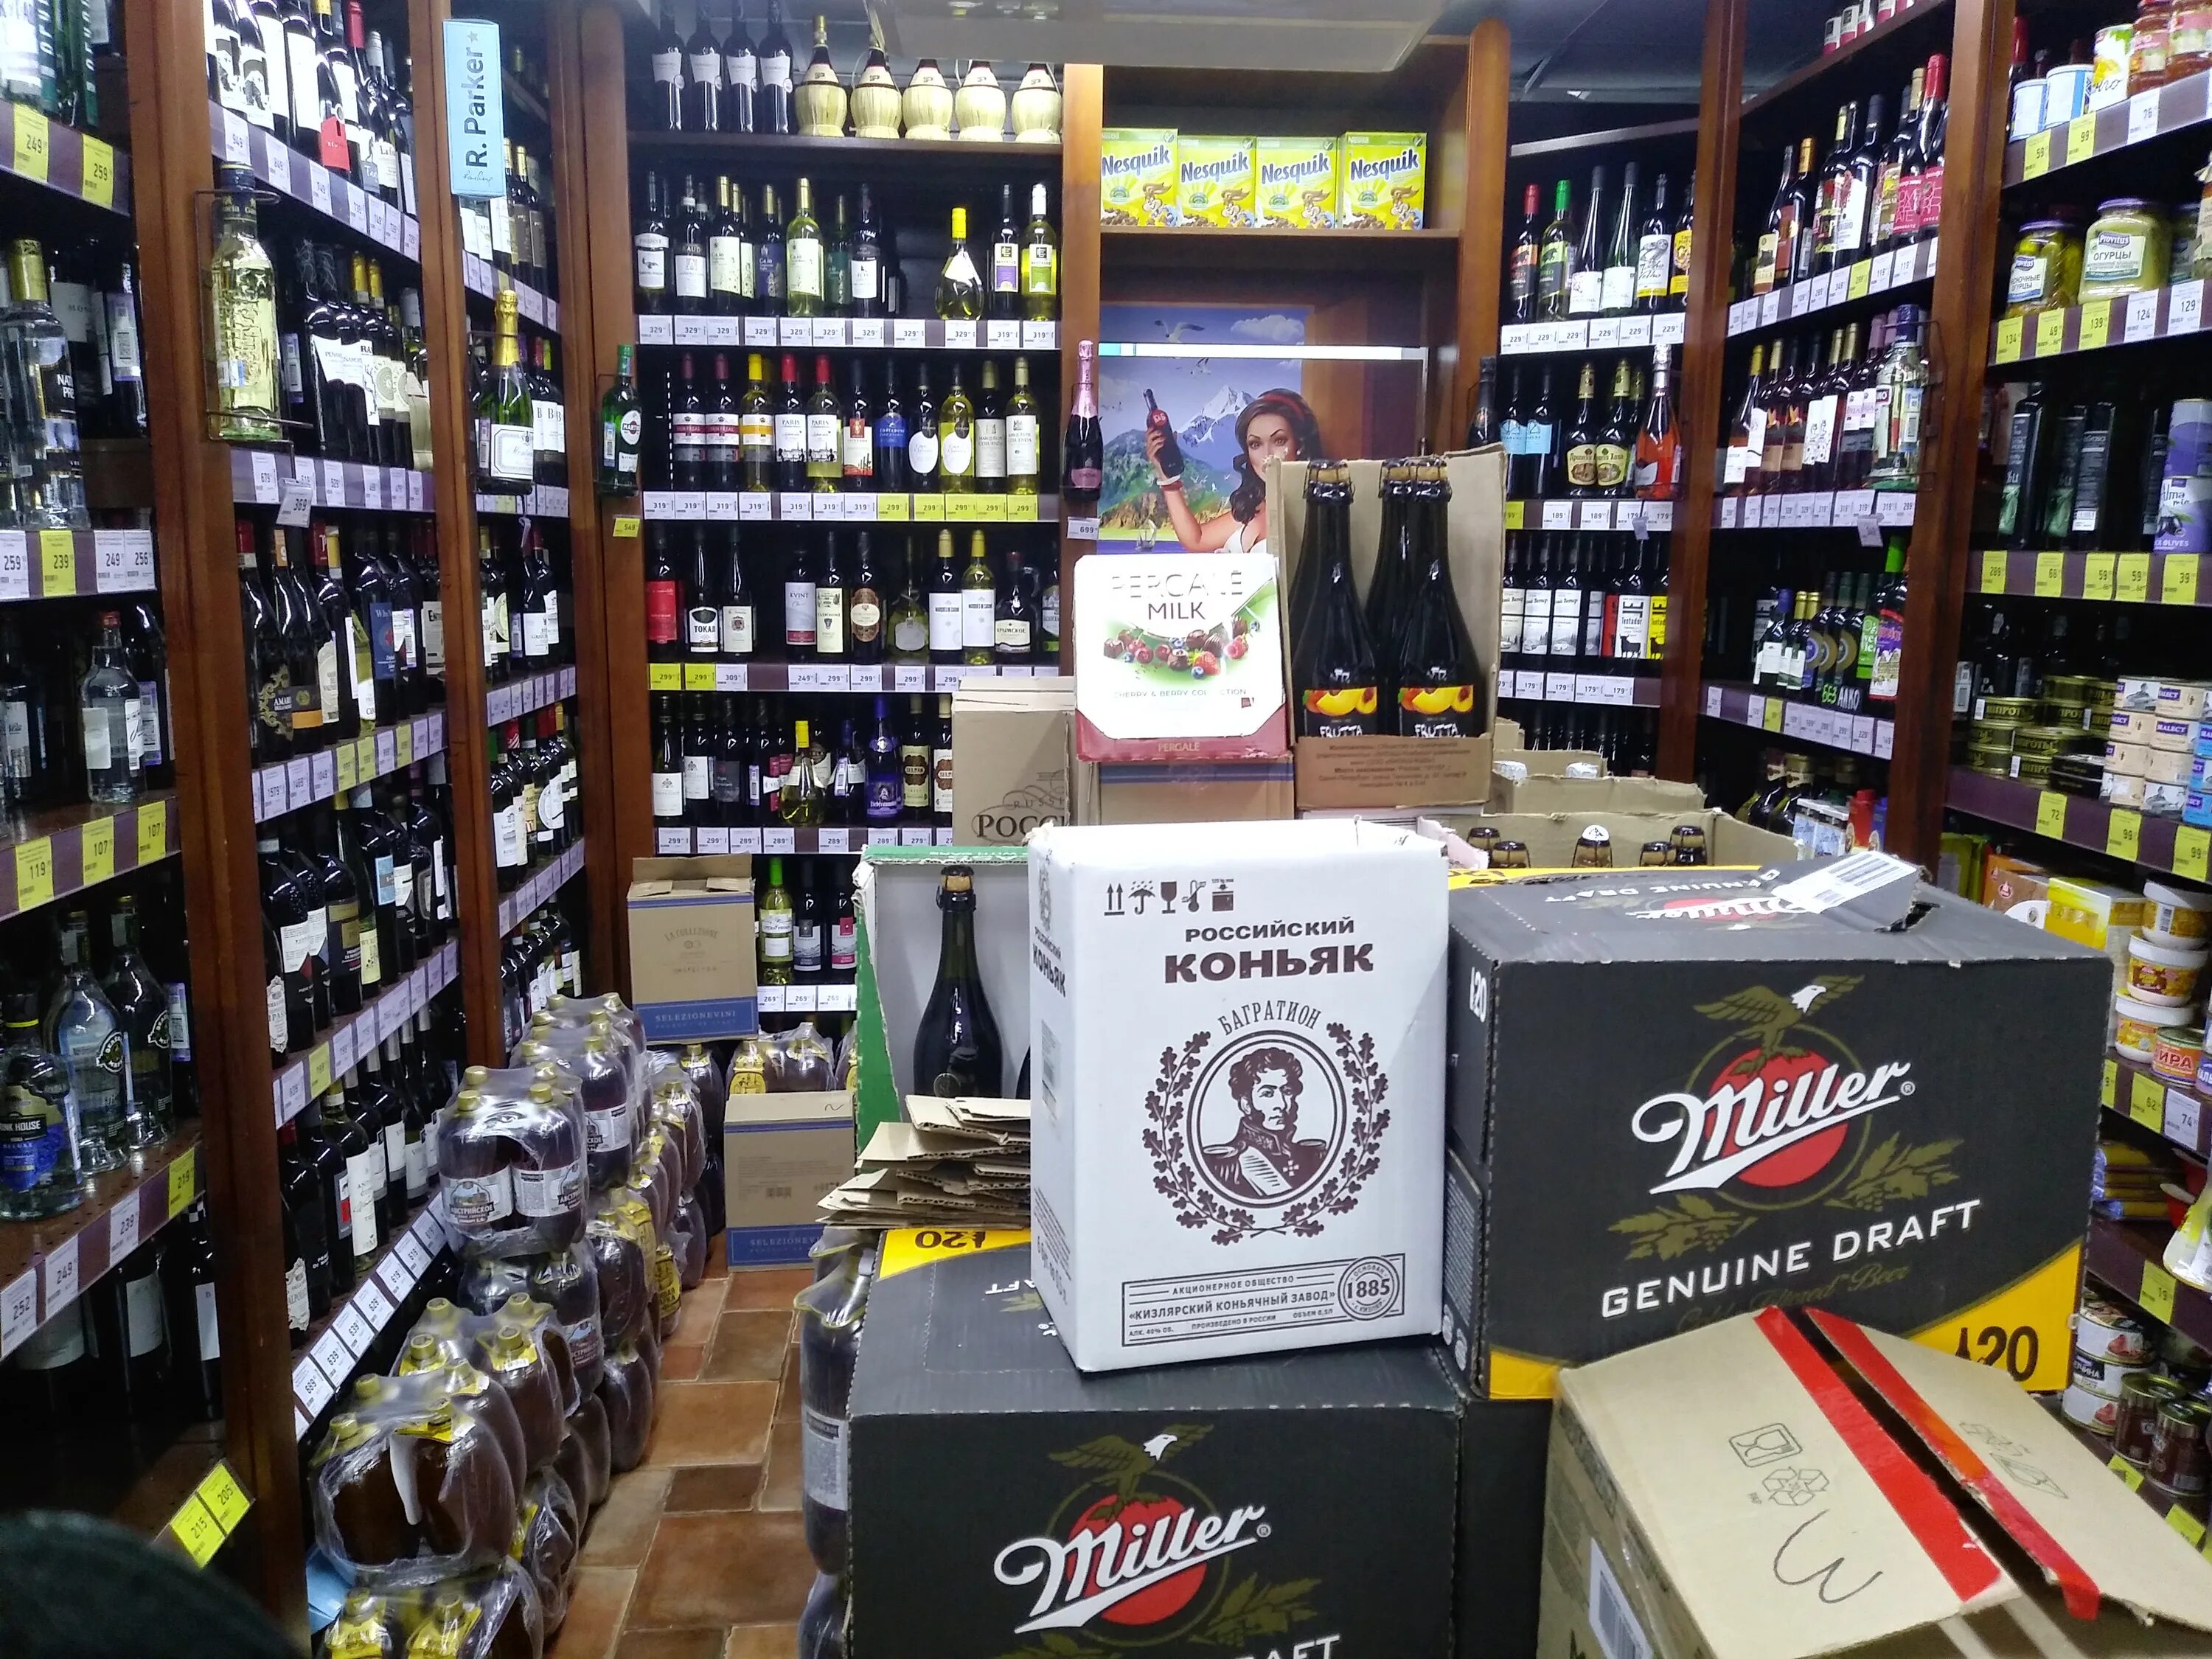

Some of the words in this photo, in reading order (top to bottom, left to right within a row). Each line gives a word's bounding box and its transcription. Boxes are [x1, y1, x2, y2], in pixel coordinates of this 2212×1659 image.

[461, 46, 487, 135] Parker
[465, 143, 488, 168] R.
[1102, 145, 1170, 176] Nesquik
[1181, 152, 1249, 183] Nesquik
[1262, 153, 1329, 184] Nesquik
[1351, 149, 1419, 181] Nesquik
[2093, 251, 2132, 262] ОГУРЦЫ
[2138, 308, 2150, 320] 124
[2181, 300, 2196, 312] 129
[2049, 326, 2058, 336] 49
[2090, 318, 2103, 330] 139
[2006, 334, 2017, 344] 134
[293, 498, 307, 512] 369
[4, 555, 21, 571] 259
[54, 554, 69, 570] 239
[105, 552, 120, 567] 249
[135, 552, 148, 565] 256
[2098, 569, 2107, 580] 59
[2132, 571, 2142, 581] 59
[2180, 573, 2190, 583] 39
[1148, 602, 1206, 620] MILK
[1319, 724, 1363, 737] FRUTTA
[1414, 723, 1458, 737] FRUTTA
[2051, 809, 2059, 821] 72
[148, 822, 160, 839] 107
[94, 840, 108, 856] 107
[29, 862, 46, 880] 119
[1185, 915, 1354, 943] РОССИЙСКИЙ
[1032, 942, 1066, 998] КОНЬЯК
[1164, 942, 1374, 984] КОНЬЯК
[655, 1009, 736, 1022] SELEZIONEVINI
[1218, 1000, 1322, 1036] БАГРАТИОН
[2146, 1096, 2157, 1111] 62
[15, 1120, 41, 1130] HOUSE
[1632, 1061, 1912, 1194] Miller
[2182, 1113, 2193, 1127] 74
[119, 1214, 134, 1235] 239
[1602, 1242, 1812, 1320] GENUINE
[1832, 1200, 1982, 1263] DRAFT
[57, 1262, 72, 1284] 249
[1172, 1281, 1242, 1295] АКЦИОНЕРНОЕ
[1245, 1275, 1294, 1288] ОБЩЕСТВО
[1346, 1278, 1391, 1299] 1885
[13, 1296, 30, 1321] 252
[1129, 1303, 1213, 1320] «КИЗЛЯРСКИЙ
[1216, 1293, 1288, 1311] КОНЬЯЧНЫЙ
[1290, 1290, 1336, 1303] ЗАВОД»
[348, 1323, 359, 1337] 639
[1192, 1318, 1240, 1330] ПРОИЗВЕДЕНО
[1249, 1315, 1276, 1324] РОССИИ
[327, 1350, 338, 1366] 639
[305, 1378, 316, 1394] 689
[218, 1484, 234, 1506] 205
[190, 1518, 207, 1540] 215
[993, 1506, 1266, 1635] Miller
